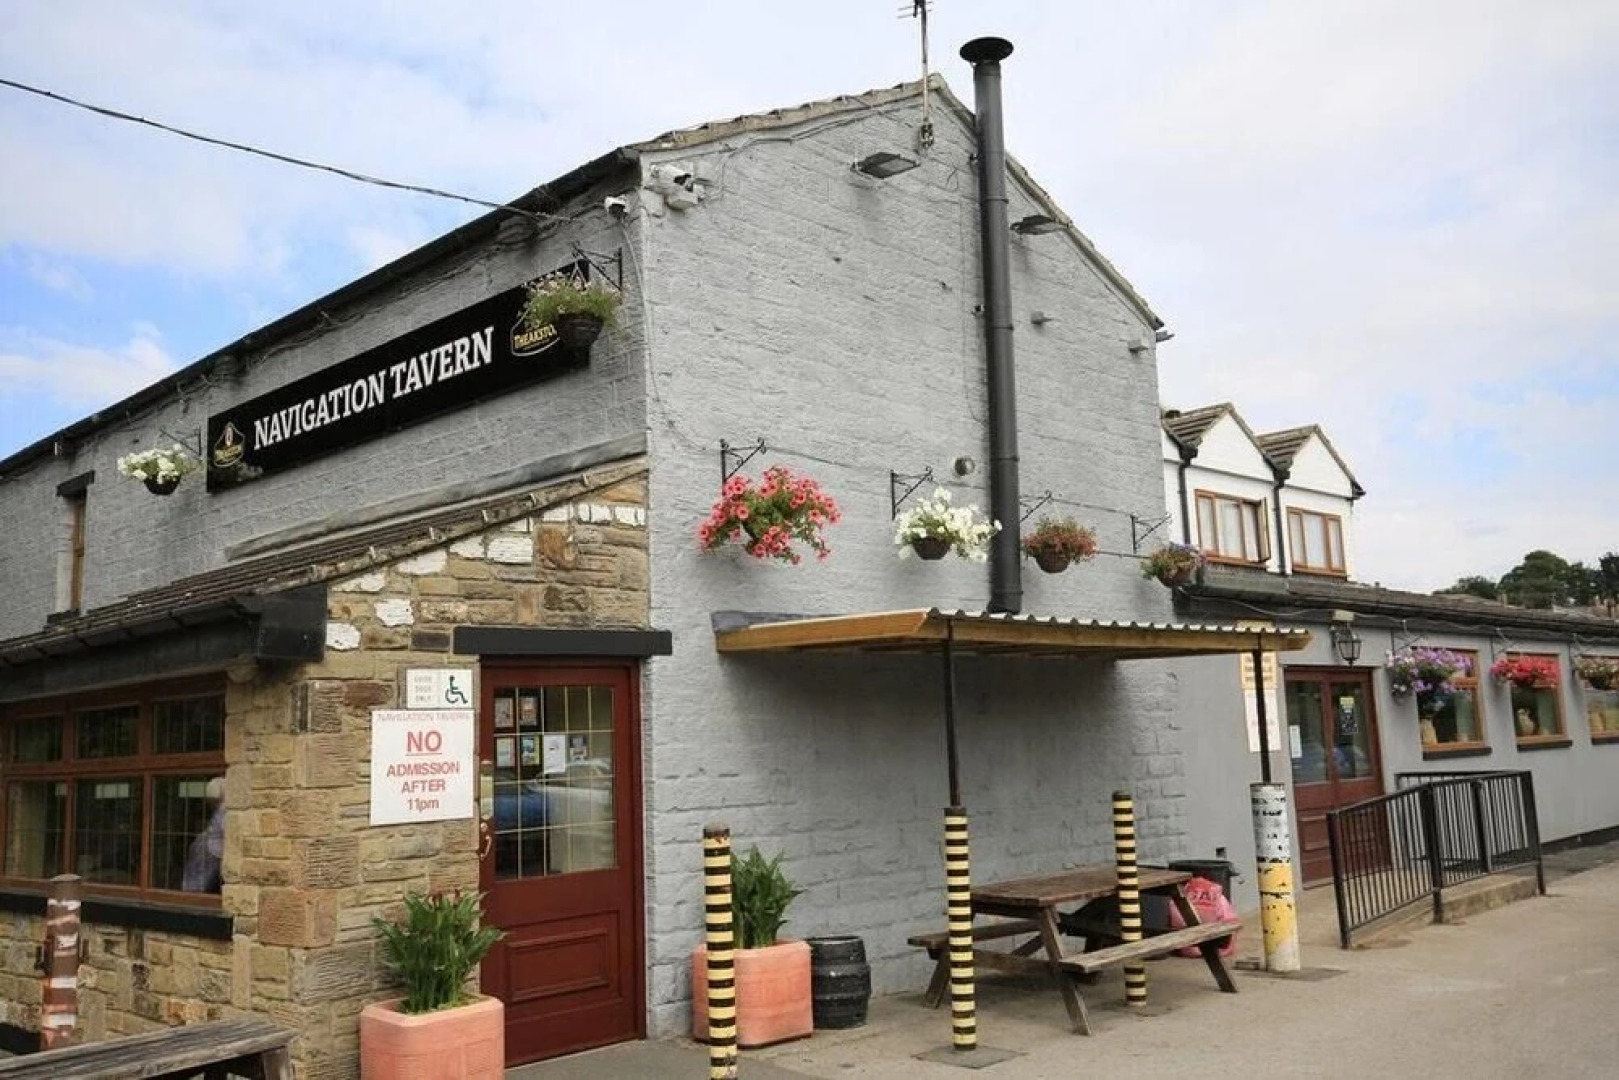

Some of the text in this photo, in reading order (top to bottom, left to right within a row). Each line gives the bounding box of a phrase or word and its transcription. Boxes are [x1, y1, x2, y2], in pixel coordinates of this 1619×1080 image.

[254, 326, 495, 451] NAVIGATION TAVERN
[407, 730, 442, 752] NO
[386, 761, 460, 777] ADMISSION
[401, 779, 446, 794] AFTER
[408, 798, 440, 813] 11pm
